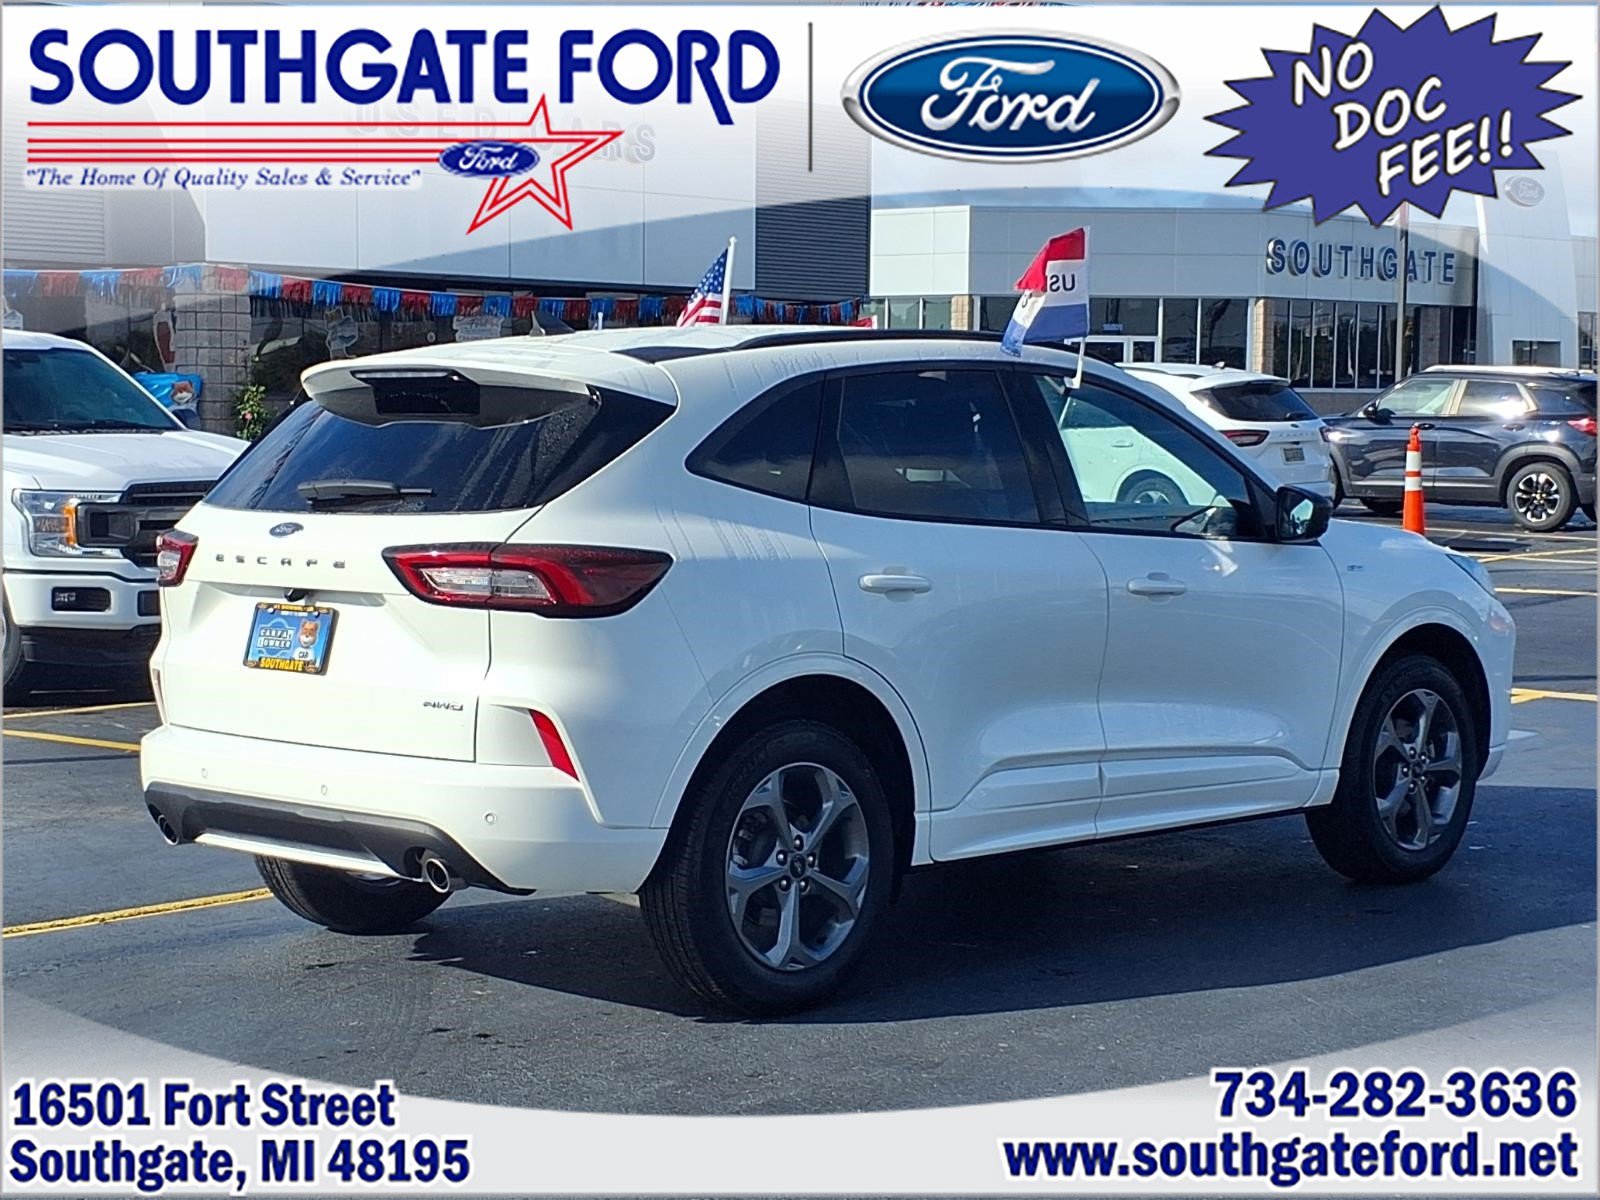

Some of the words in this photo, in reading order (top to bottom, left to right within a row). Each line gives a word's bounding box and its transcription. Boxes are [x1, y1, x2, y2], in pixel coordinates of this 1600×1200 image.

[1266, 238, 1456, 284] SOUTHGATE
[215, 553, 346, 569] ESCAPE
[260, 656, 304, 672] SOUTHGATE
